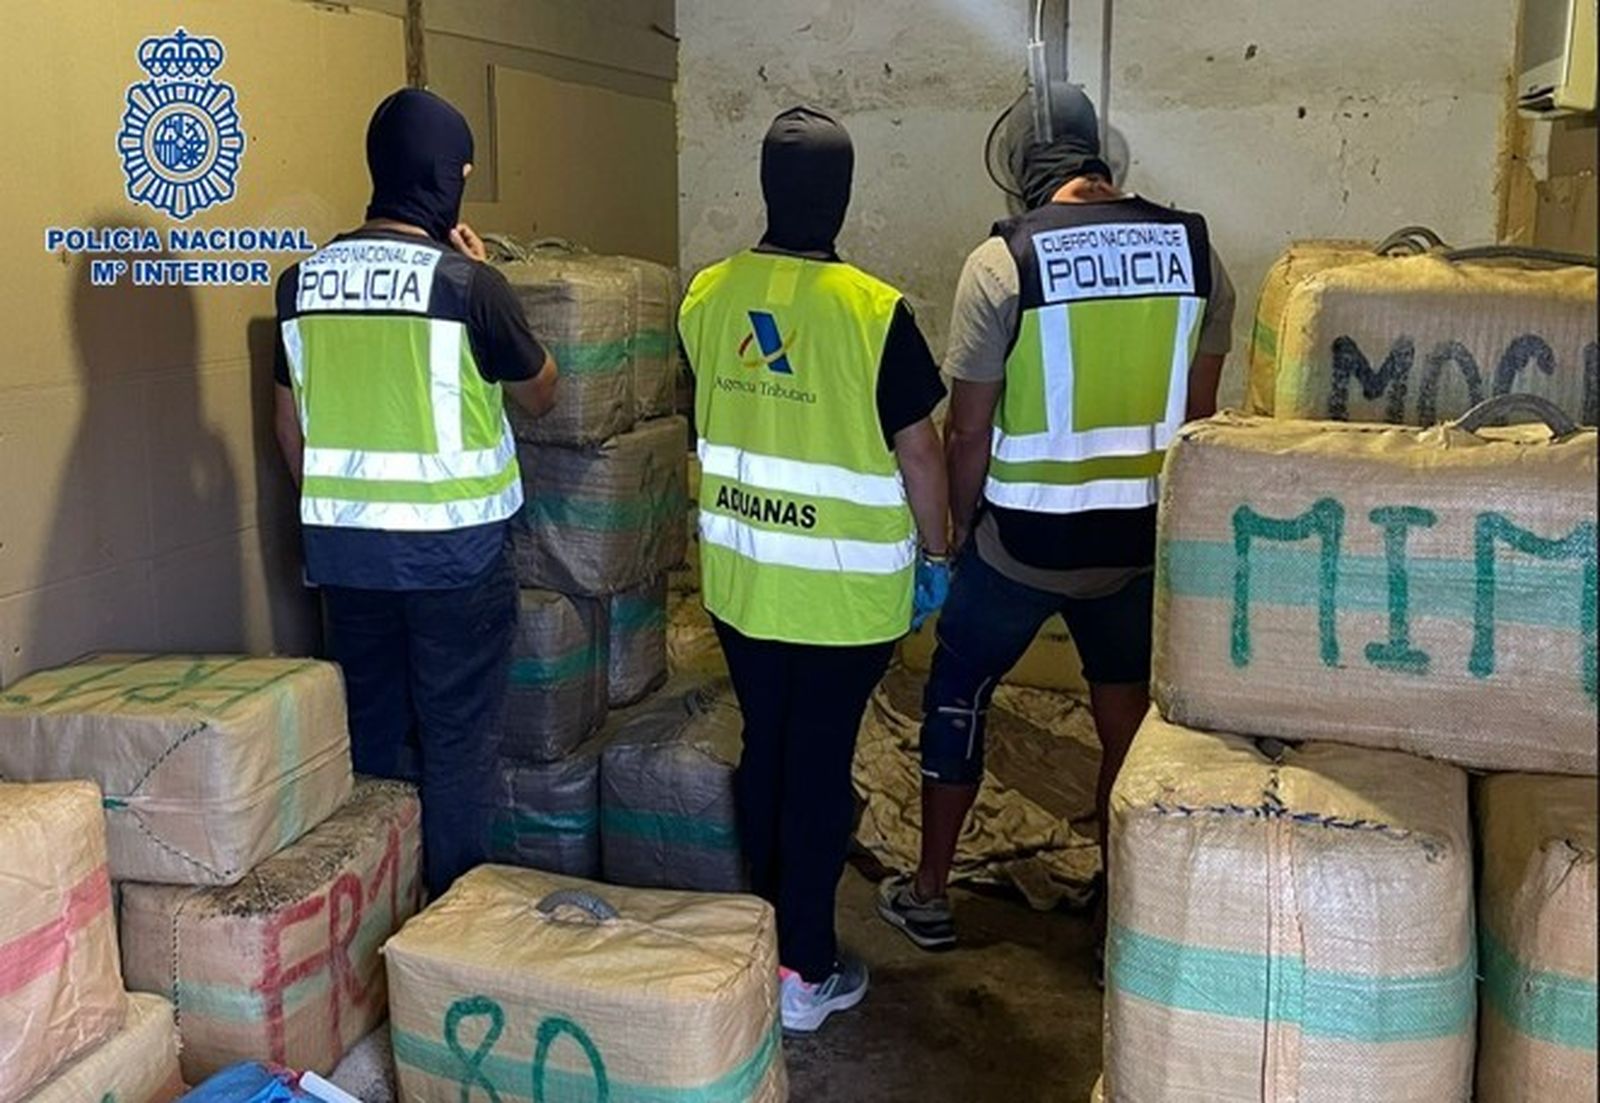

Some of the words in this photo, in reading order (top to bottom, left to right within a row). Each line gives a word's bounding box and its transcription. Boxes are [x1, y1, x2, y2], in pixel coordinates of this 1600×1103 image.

[350, 246, 408, 264] NACIONAL
[411, 250, 432, 267] DE
[1041, 231, 1098, 252] CUERPO
[1100, 229, 1164, 248] NACIONAL
[300, 268, 421, 303] POLICIA
[1046, 252, 1188, 292] POLICIA
[716, 486, 817, 528] ADUANAS
